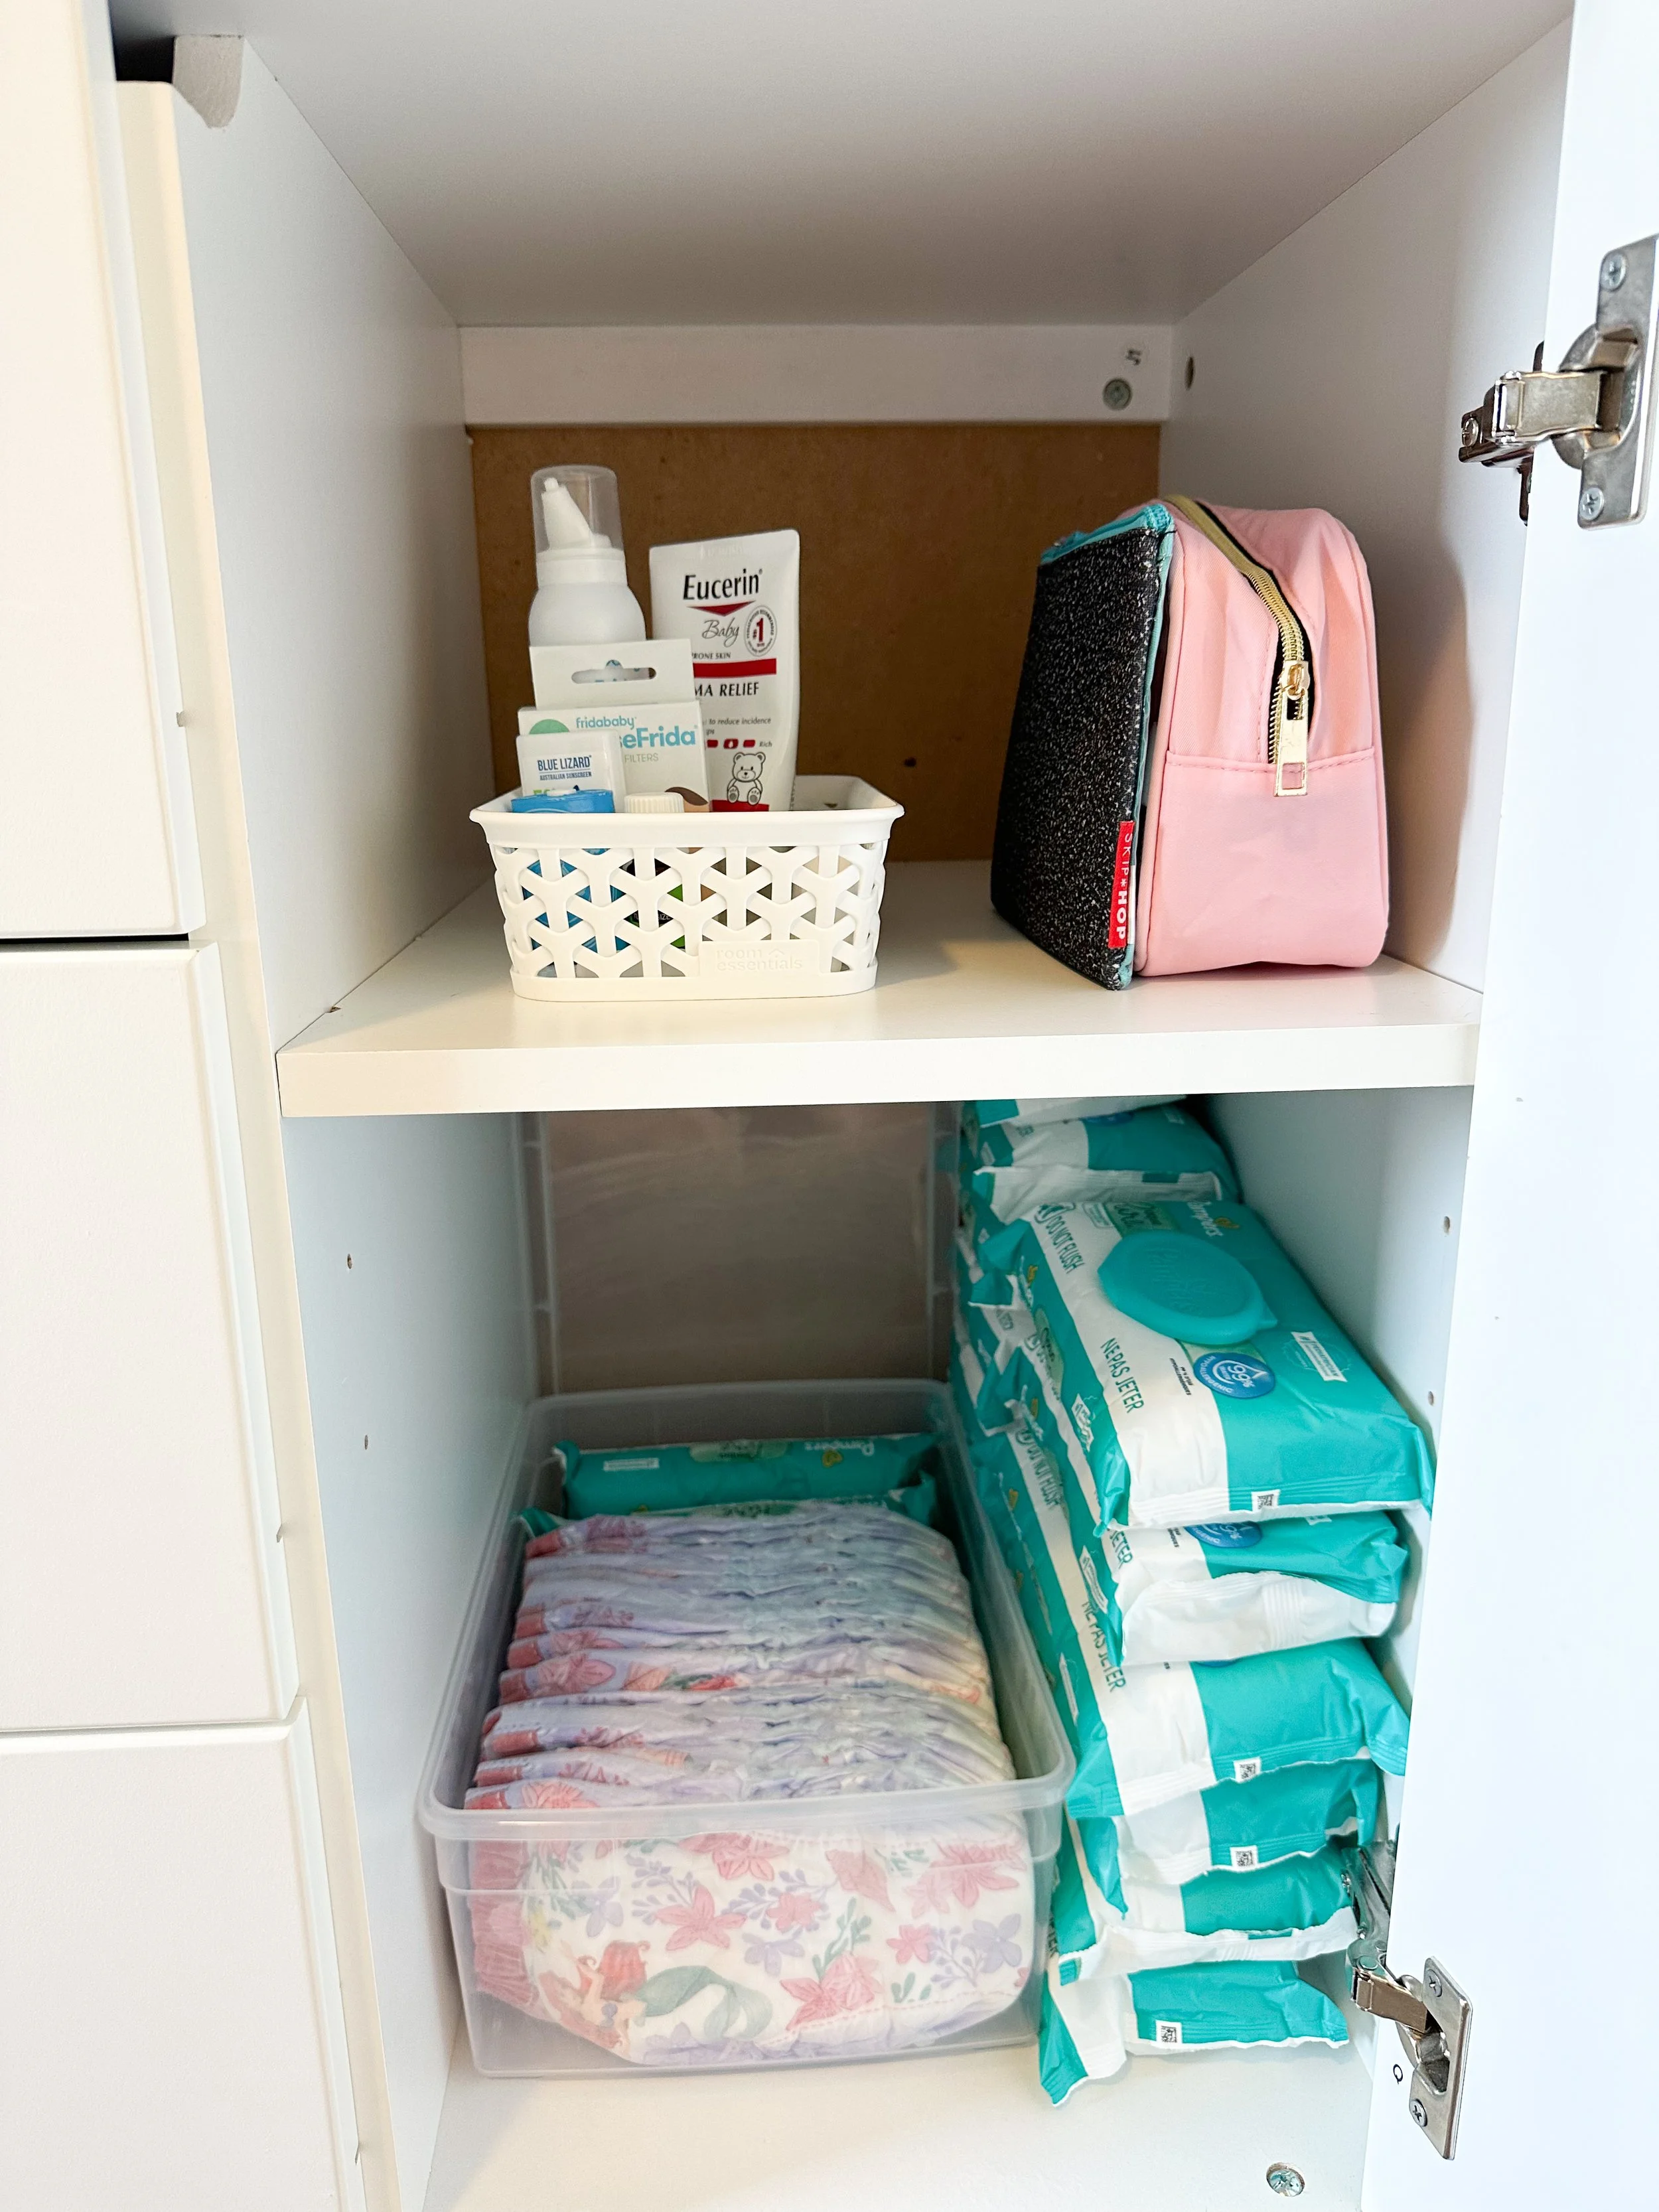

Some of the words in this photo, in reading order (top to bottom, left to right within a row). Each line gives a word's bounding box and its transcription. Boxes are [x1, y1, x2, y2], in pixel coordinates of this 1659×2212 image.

[684, 569, 760, 600] Eucerin
[702, 617, 740, 648] Baby
[720, 682, 760, 696] RELIEF
[576, 715, 635, 730] fridababy
[741, 717, 772, 725] incidence
[620, 725, 696, 749] eFrida
[538, 759, 558, 771] BLUE
[560, 756, 591, 770] LIZARD
[624, 753, 658, 763] FILTERS
[540, 773, 565, 781] AUSTRALIAN
[716, 949, 762, 960] room
[717, 955, 803, 972] essentials
[1226, 1364, 1256, 1388] 99%
[1116, 1376, 1144, 1413] JETER
